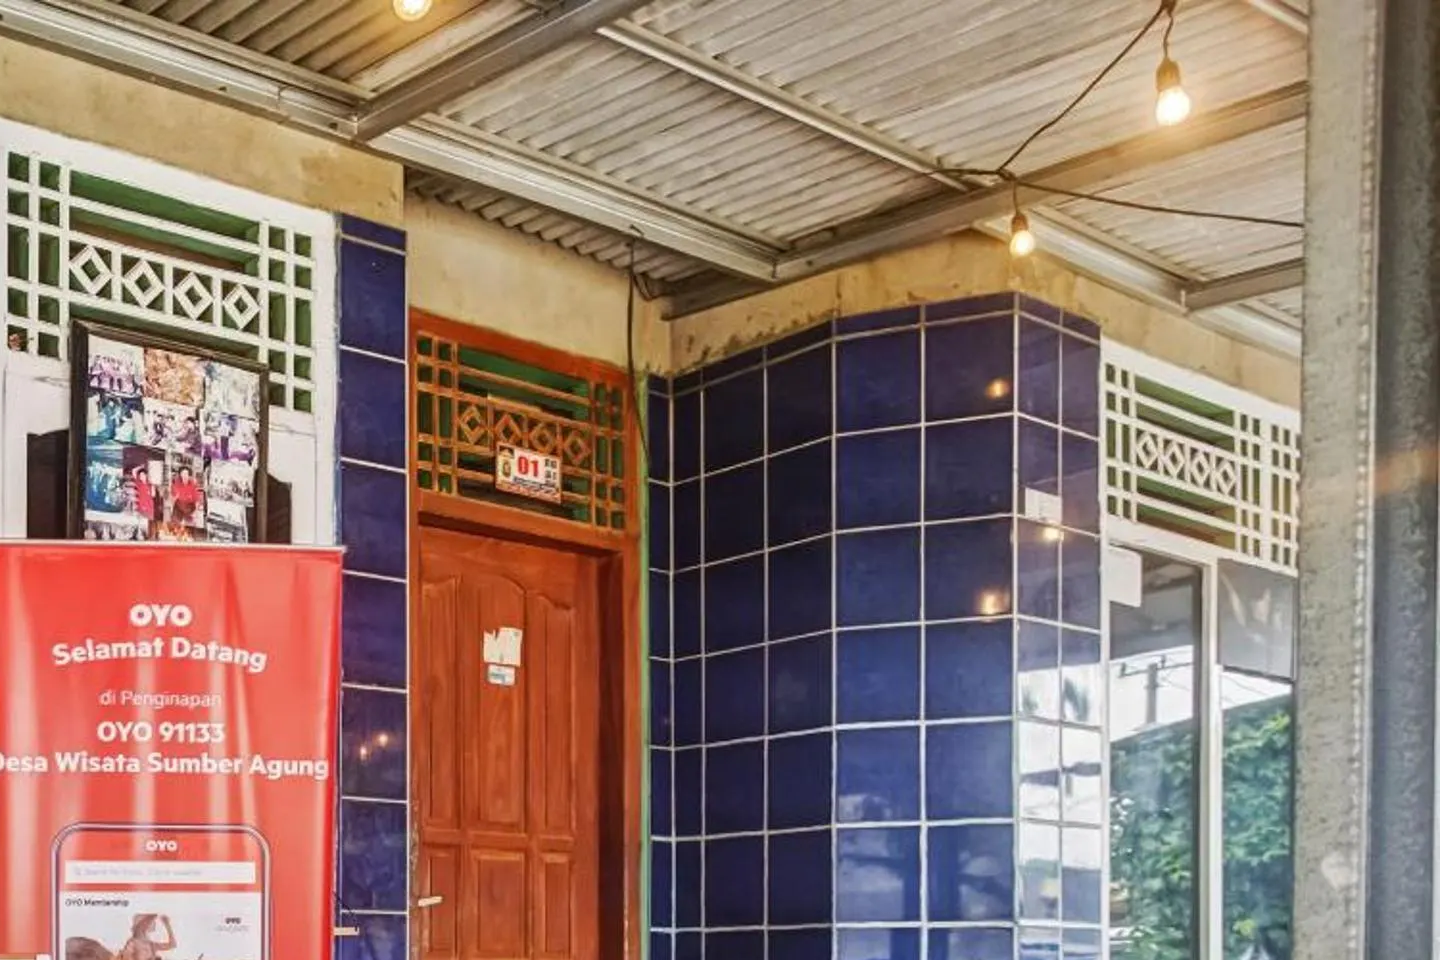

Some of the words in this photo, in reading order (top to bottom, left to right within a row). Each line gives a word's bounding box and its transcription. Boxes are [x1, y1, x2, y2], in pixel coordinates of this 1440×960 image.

[518, 456, 539, 477] 01
[130, 604, 192, 627] OYO
[52, 637, 163, 666] Selamat
[171, 636, 267, 673] Datang
[99, 690, 116, 706] di
[120, 690, 222, 710] Penginapan
[97, 721, 153, 743] OYO
[159, 721, 226, 743] 91133
[55, 752, 142, 774] Wisata
[147, 752, 243, 774] Sumber
[249, 755, 329, 781] Agung
[146, 839, 177, 852] OYO
